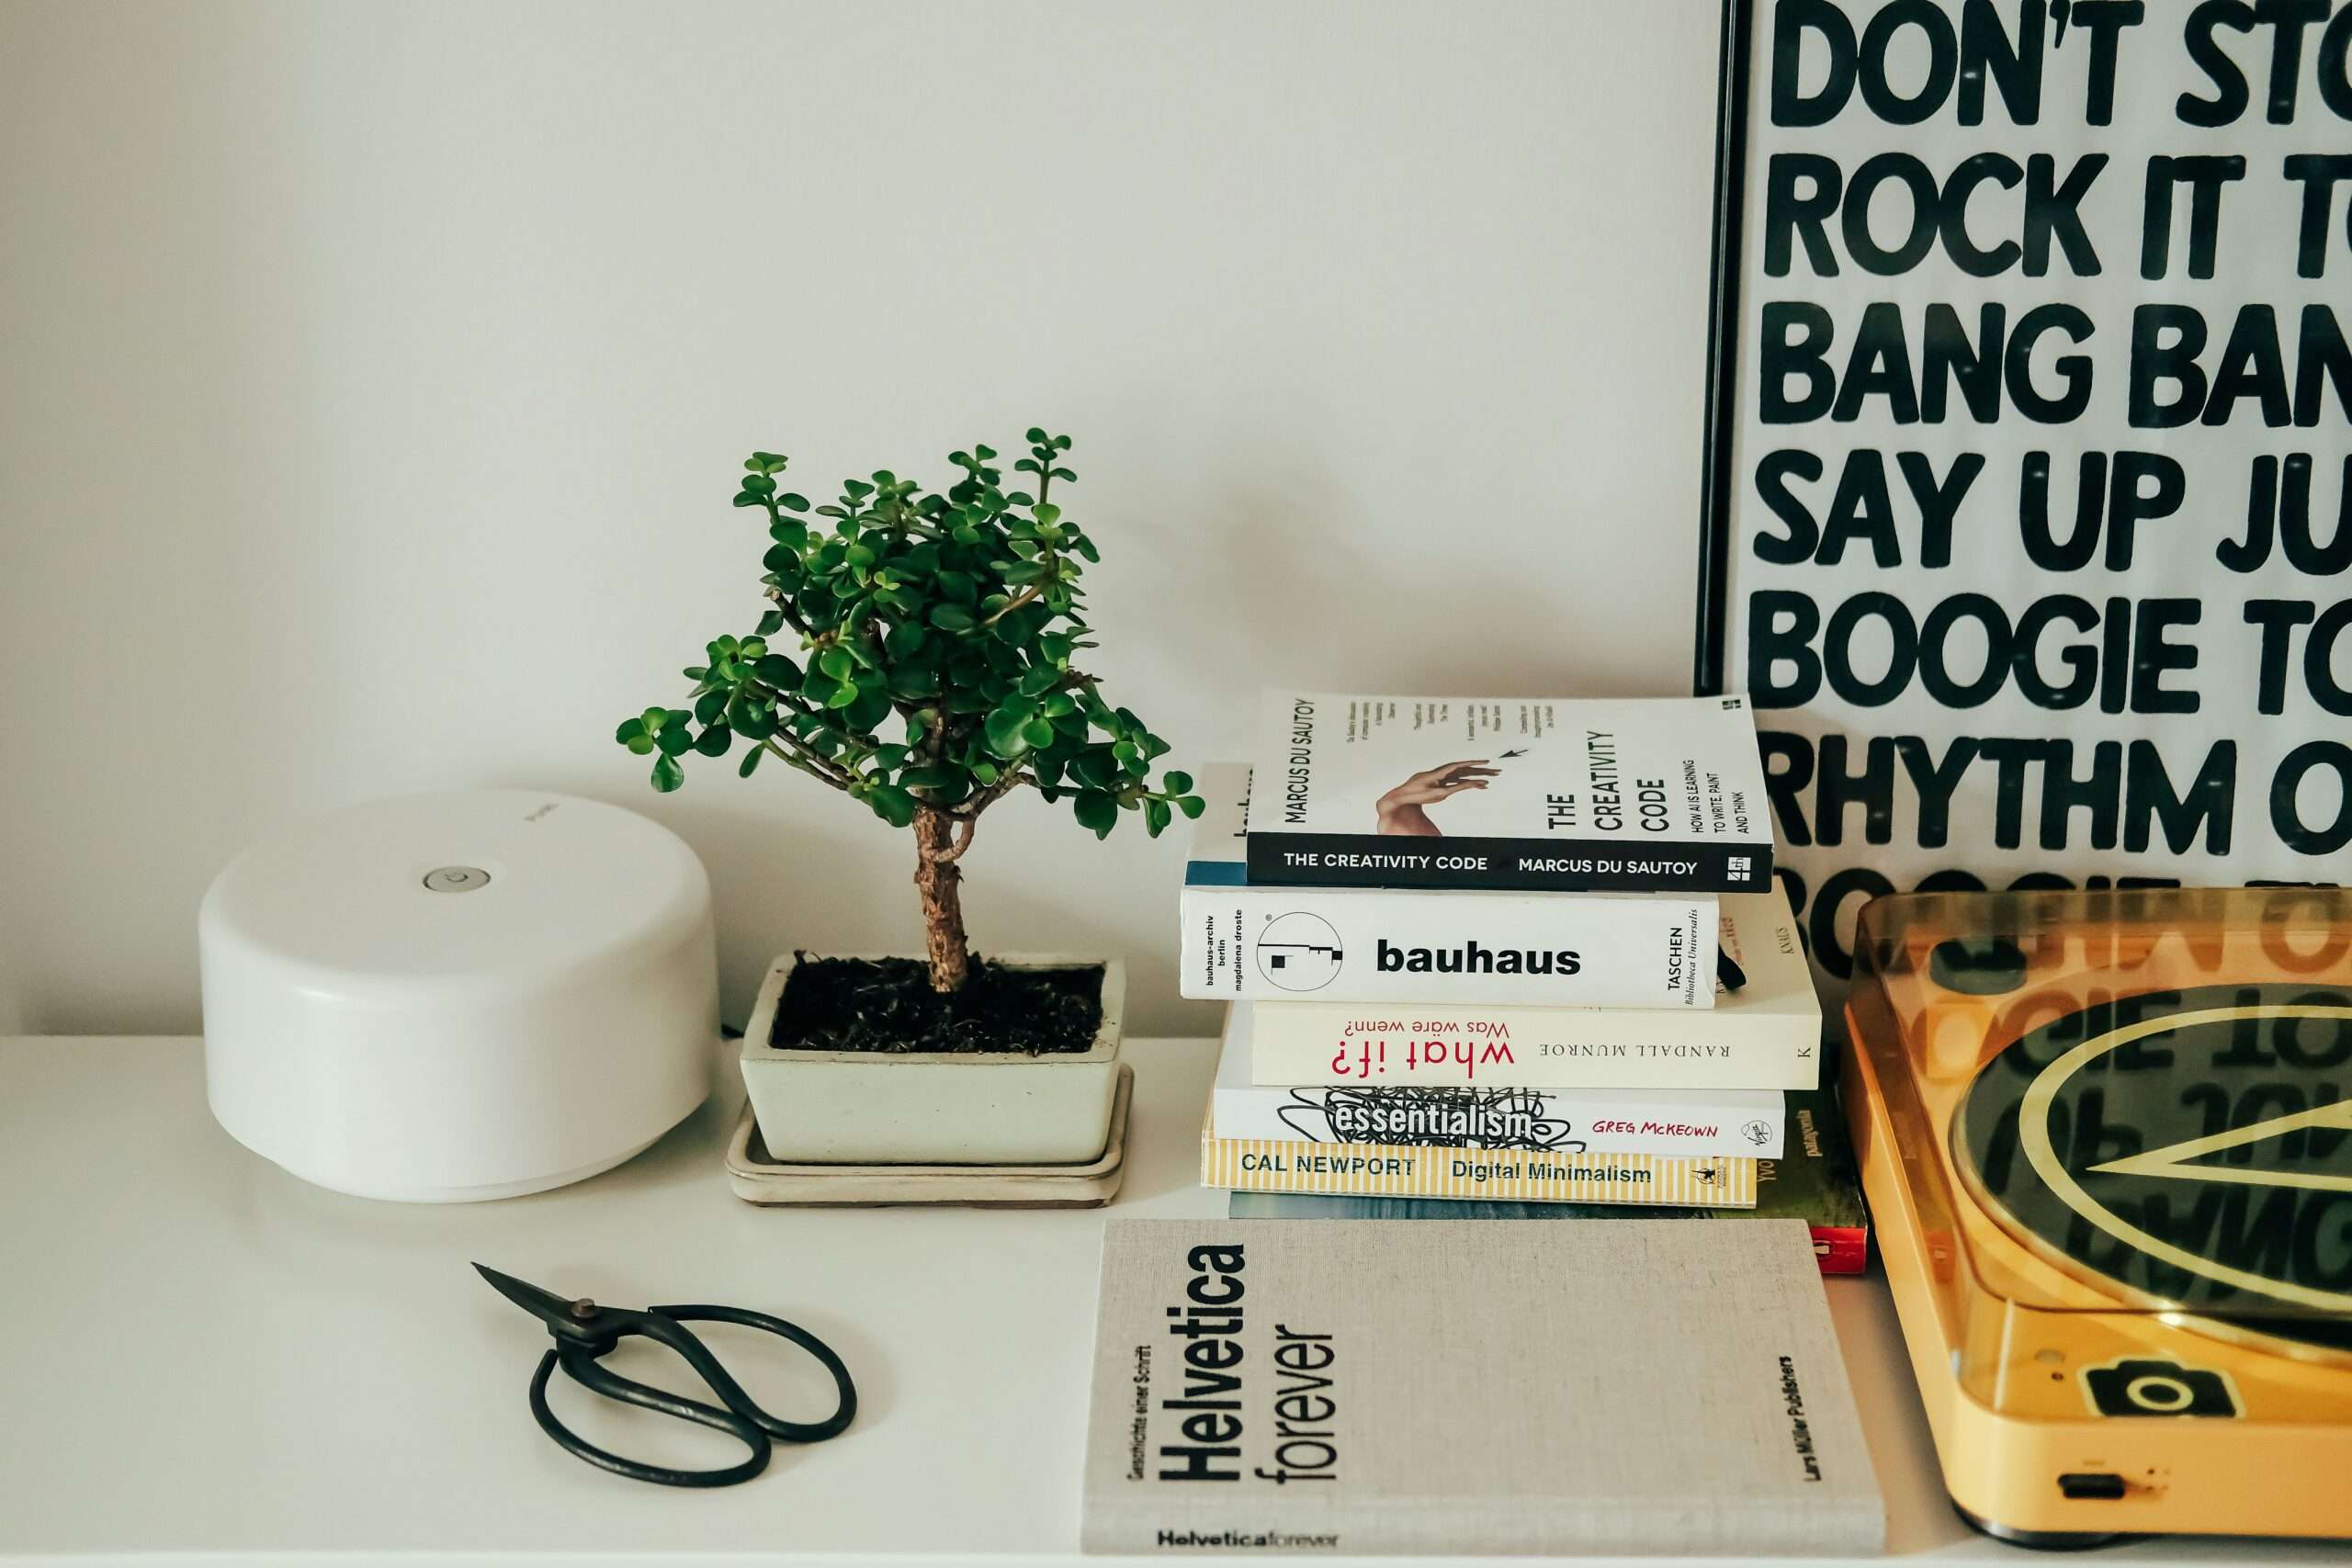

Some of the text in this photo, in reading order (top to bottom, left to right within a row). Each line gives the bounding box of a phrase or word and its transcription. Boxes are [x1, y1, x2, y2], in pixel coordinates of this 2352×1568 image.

[1770, 0, 2144, 127] DON'T
[1763, 152, 2352, 280] ROCK IT T
[1759, 301, 2096, 424] BANG
[1753, 448, 1986, 568] SAY
[2019, 450, 2186, 571] UP
[1747, 590, 2202, 715] BOOGIE
[1284, 699, 1315, 823] MARCUS DU SAUTOY
[1587, 730, 1623, 831] CREATIVITY
[1706, 773, 1721, 794] PAINT
[1546, 794, 1576, 829] THE
[1636, 779, 1669, 832] CODE
[1682, 760, 1704, 833] HOW AI IS LEARNING
[1732, 792, 1750, 834] AND THINK
[1756, 730, 2237, 855] RHYTHM
[1713, 821, 1727, 833] TO
[1283, 852, 1698, 875] THE CREATIVITY CODE MARCUS DU SAUTOY
[1204, 915, 1214, 987] bauhaus-archiv
[1216, 939, 1226, 967] berlin
[1233, 908, 1243, 992] magdalena droste
[1376, 939, 1581, 976] bauhaus
[1668, 927, 1683, 991] TASCHEN
[1685, 908, 1698, 1006] Bibliotheca Universalis
[1344, 1021, 1510, 1039] Was wäre wenn?
[1538, 1043, 1731, 1058] RANDALL MUNROE
[1331, 1041, 1515, 1079] what if?
[1335, 1104, 1533, 1138] essentialism
[1591, 1120, 1635, 1134] GREG
[1796, 1109, 1823, 1156] patagonia
[1241, 1153, 1416, 1176] CAL NEWPORT
[1452, 1160, 1652, 1184] Digital Minimalism
[1133, 1345, 1152, 1383] Schrift
[1159, 1243, 1246, 1482] Helvetica
[1779, 1356, 1805, 1416] Publishers
[1134, 1385, 1149, 1415] einer
[1254, 1324, 1338, 1485] forever
[1803, 1455, 1822, 1483] Lars
